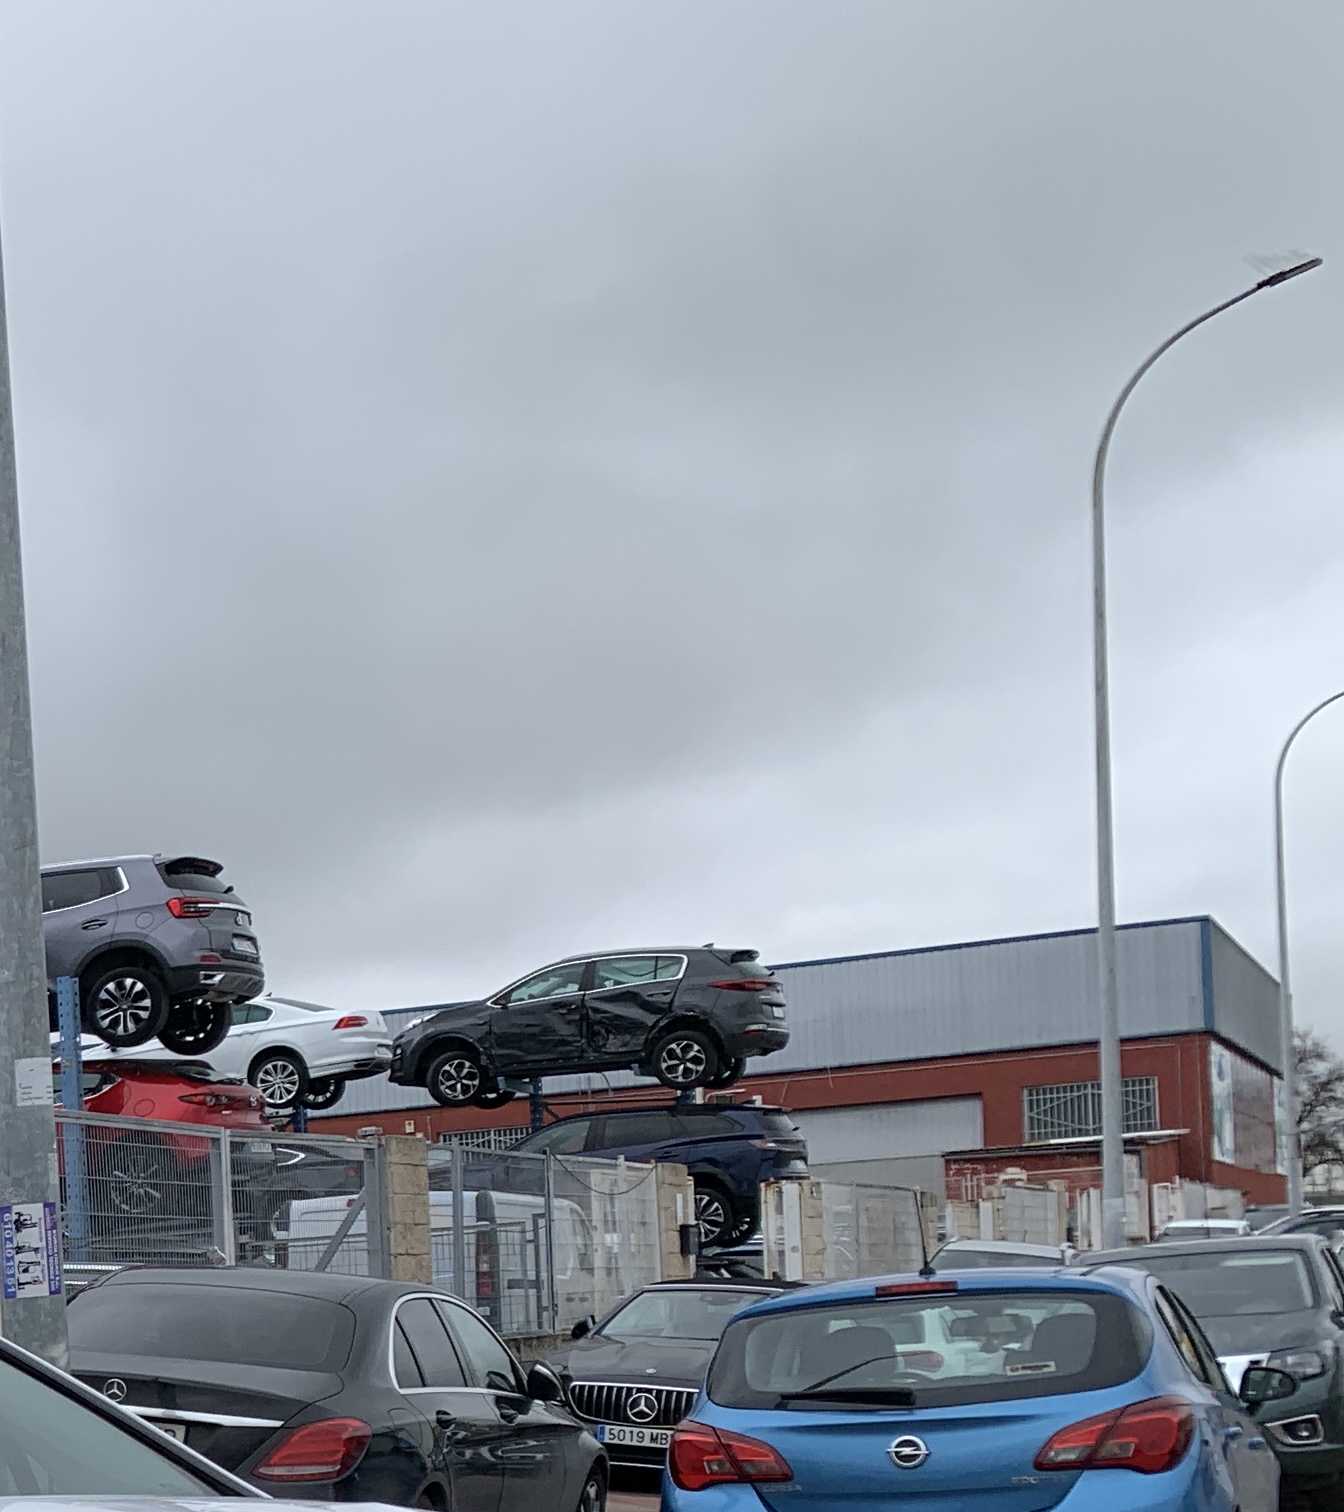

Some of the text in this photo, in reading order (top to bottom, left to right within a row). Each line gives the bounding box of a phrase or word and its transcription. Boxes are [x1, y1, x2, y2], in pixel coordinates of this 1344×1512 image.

[3, 1213, 12, 1238] 610
[609, 1428, 672, 1446] 5019 MB
